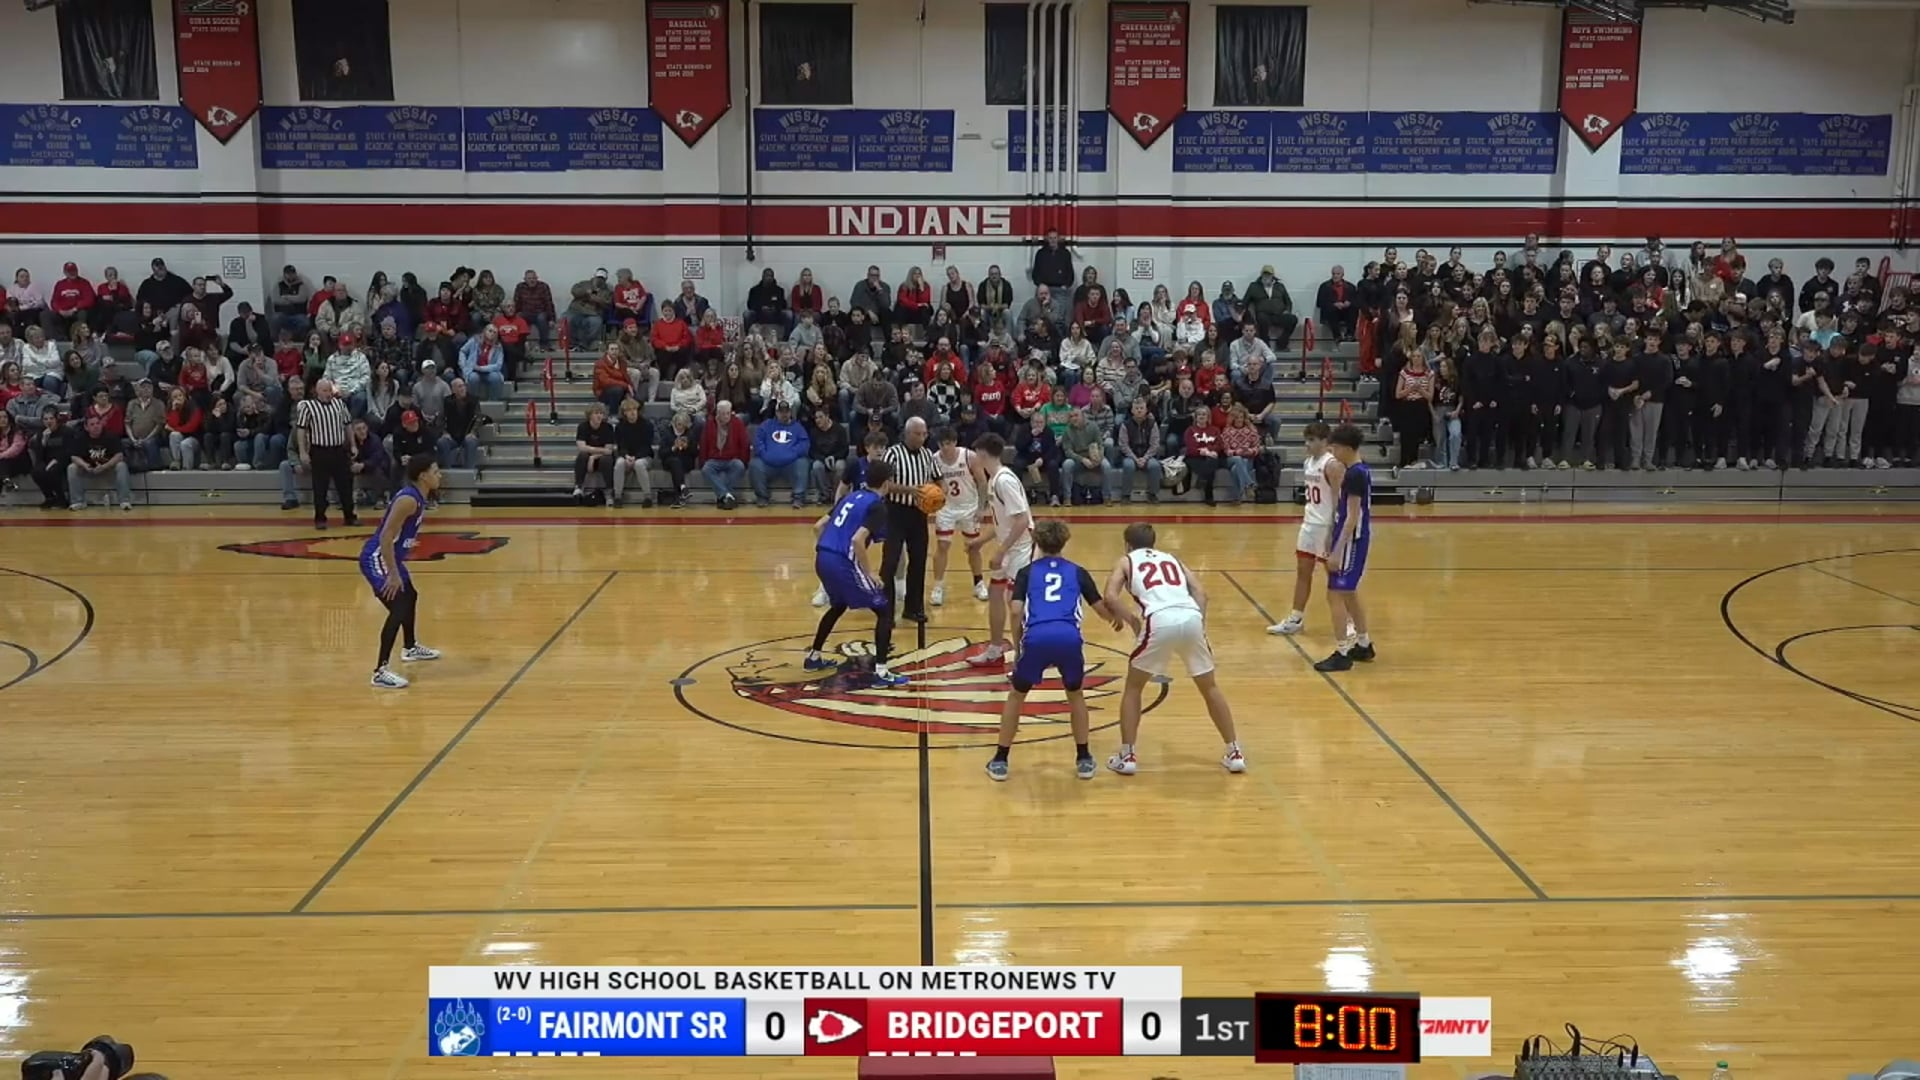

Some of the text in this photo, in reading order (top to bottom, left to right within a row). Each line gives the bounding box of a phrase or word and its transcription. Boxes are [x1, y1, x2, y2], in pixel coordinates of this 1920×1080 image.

[668, 20, 708, 28] BASEBALL
[18, 107, 82, 129] WVSSAC
[120, 108, 183, 129] WVSSAC
[279, 108, 344, 131] WVSSAC
[385, 108, 438, 125] WVSSAC
[486, 108, 539, 128] WVSSAC
[588, 109, 639, 128] WVSSAC
[778, 110, 830, 129] WVSSAC
[879, 111, 930, 129] WVSSAC
[1197, 113, 1248, 130] WVSSAC
[1296, 113, 1347, 131] WVSSAC
[1393, 113, 1443, 131] WVSSAC
[1487, 113, 1537, 132] WVSSAC
[1640, 115, 1690, 132] WVSSAC
[1729, 115, 1780, 132] WVSSAC
[1817, 116, 1869, 133] WVSSAC
[829, 206, 1010, 235] INDIANS
[949, 480, 960, 497] 3
[834, 502, 854, 528] 5
[1137, 561, 1181, 590] 20
[1044, 572, 1062, 602] 2
